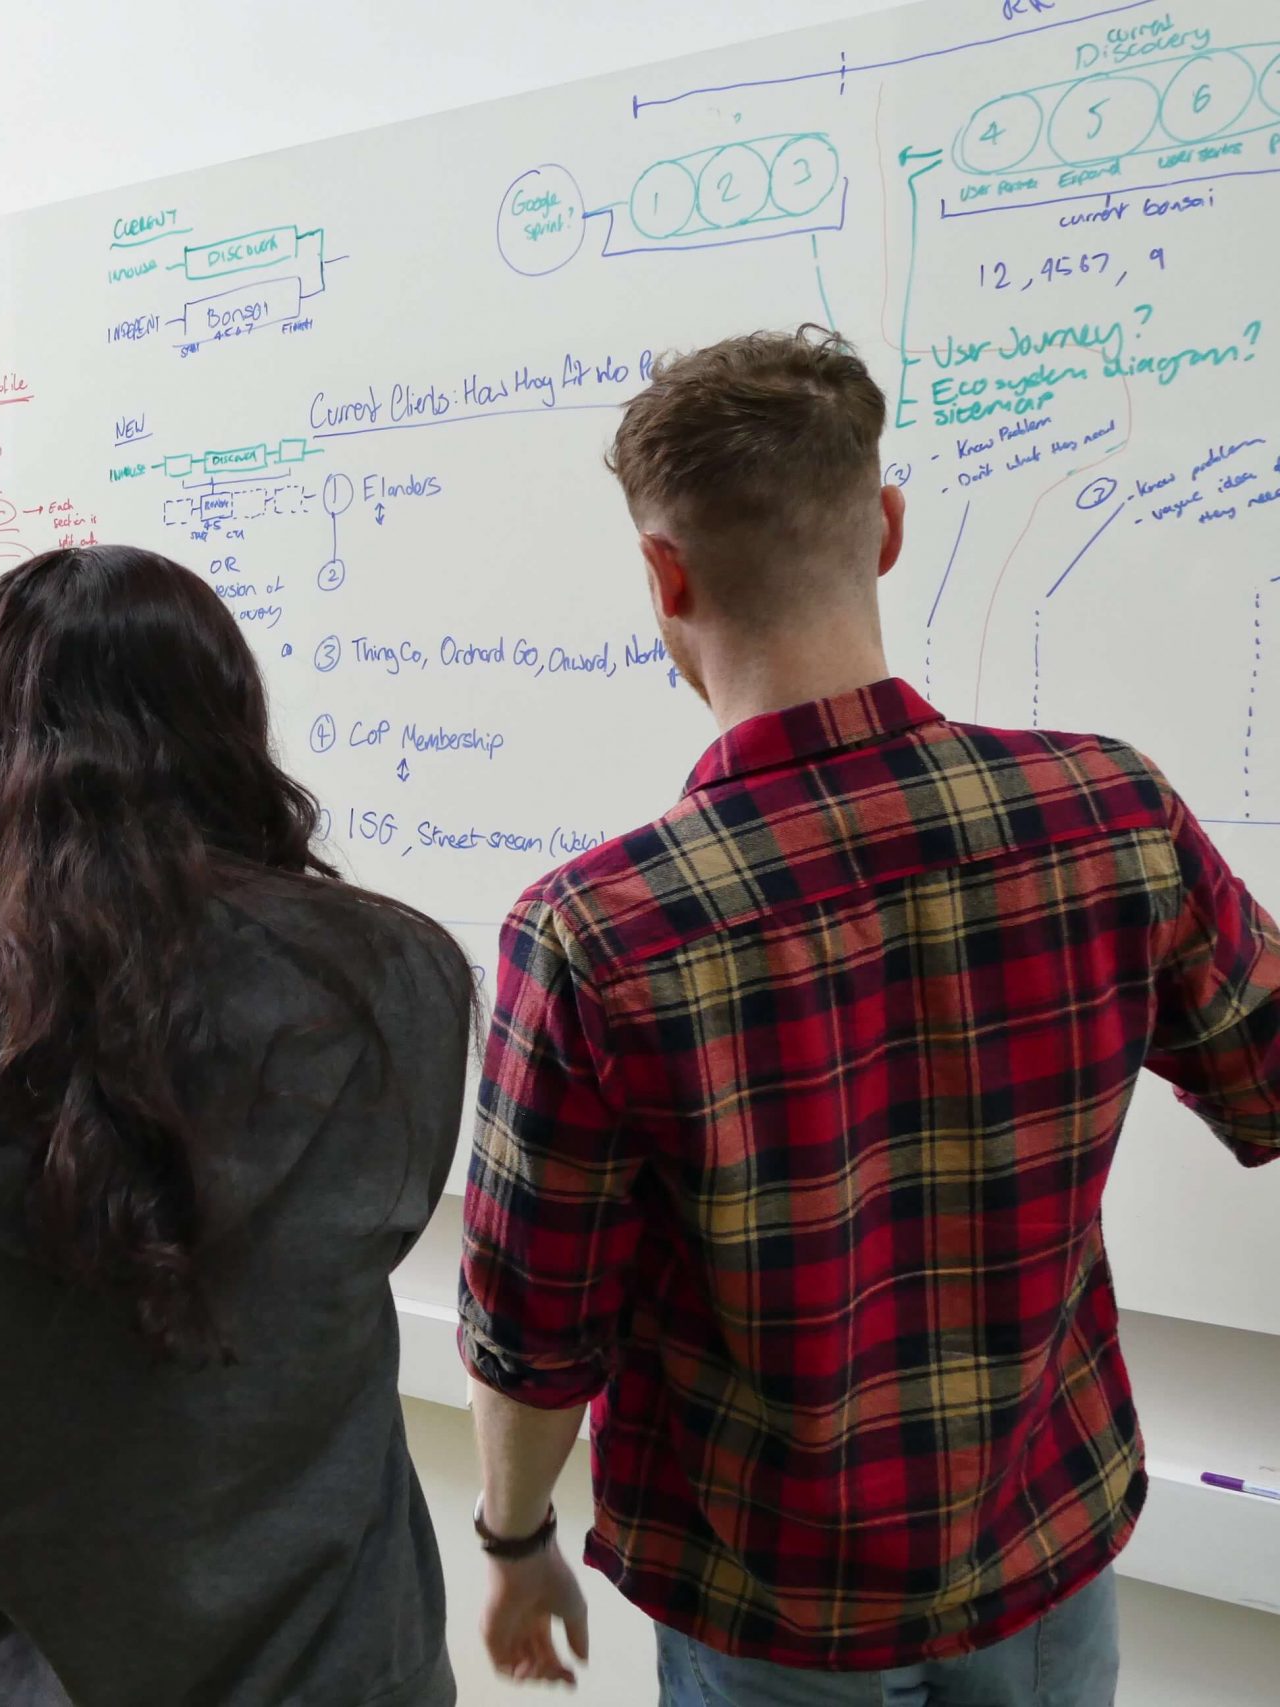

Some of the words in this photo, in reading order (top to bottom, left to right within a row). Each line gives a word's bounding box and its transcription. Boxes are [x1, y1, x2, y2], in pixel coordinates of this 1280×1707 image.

[1076, 28, 1210, 70] Discovery
[1193, 84, 1211, 113] 6
[1087, 98, 1111, 139] 5
[979, 121, 1006, 145] 4
[793, 158, 811, 186] 3
[717, 172, 741, 202] 2
[511, 190, 561, 218] Google
[1149, 248, 1165, 270] 9
[310, 386, 382, 429] Current
[464, 374, 509, 407] How
[115, 413, 145, 439] NEW
[49, 498, 74, 514] Each
[54, 513, 86, 528] section
[210, 556, 241, 574] OR
[402, 724, 504, 759] Membership
